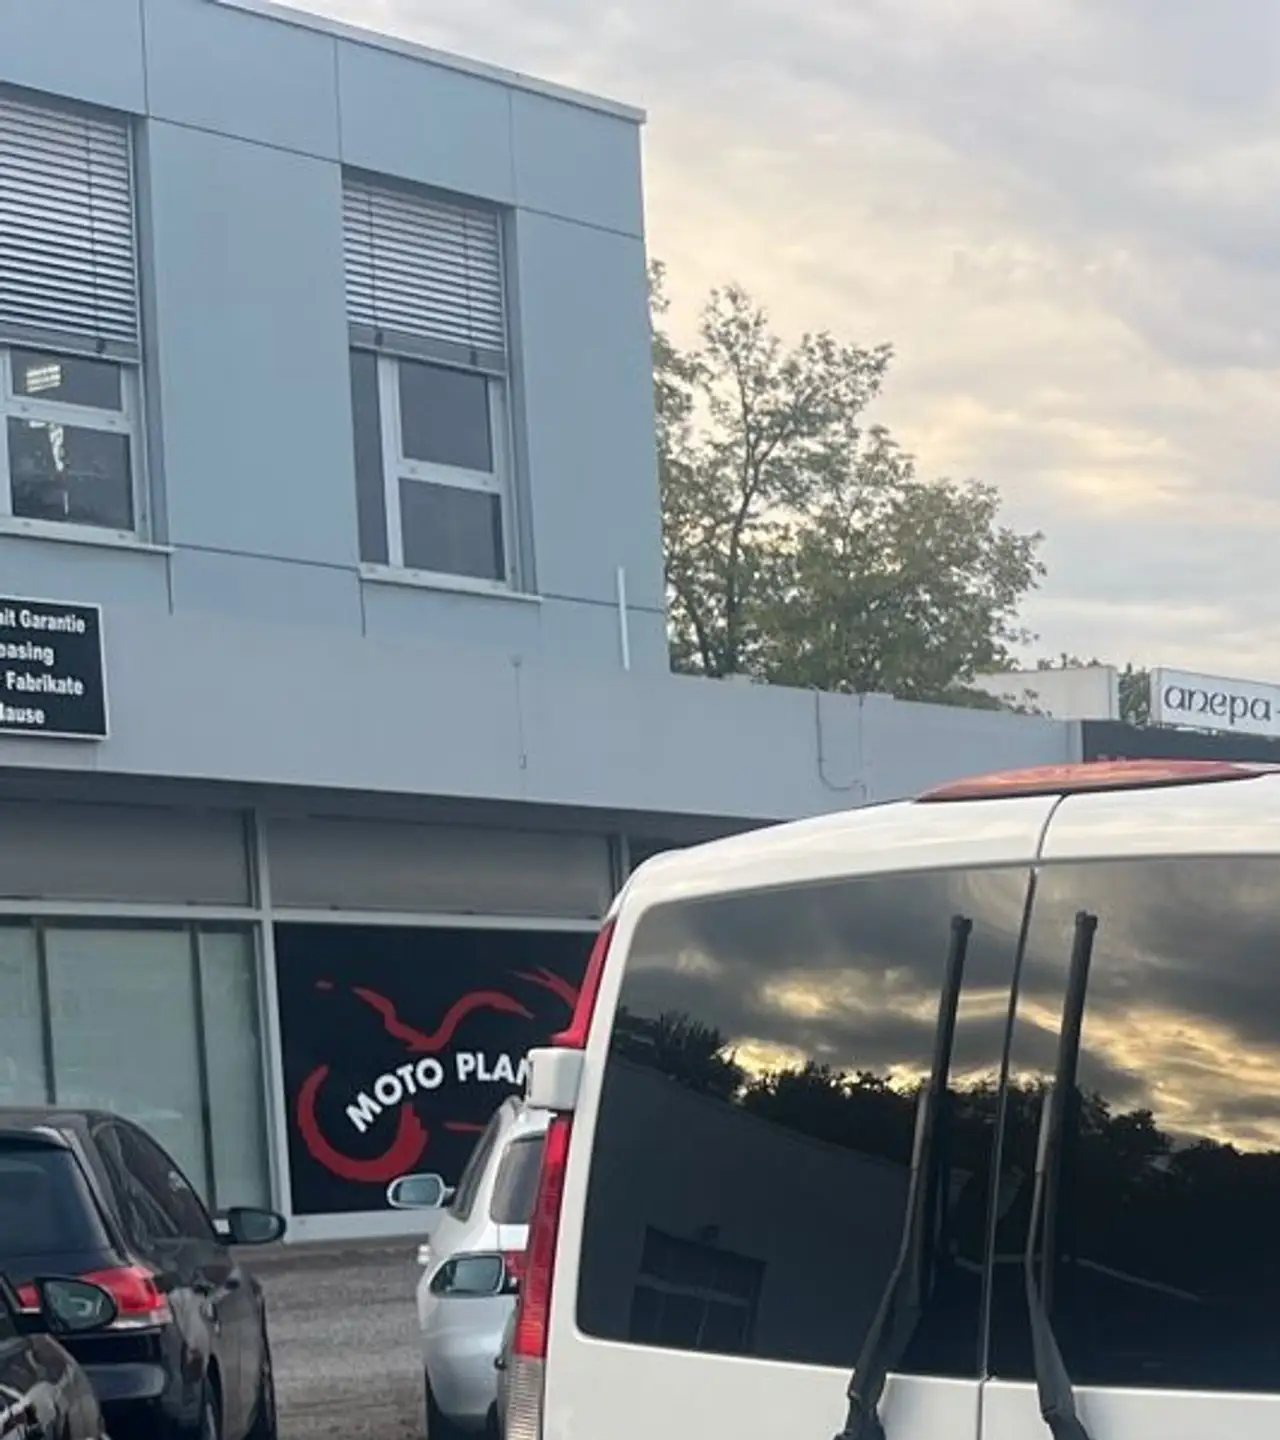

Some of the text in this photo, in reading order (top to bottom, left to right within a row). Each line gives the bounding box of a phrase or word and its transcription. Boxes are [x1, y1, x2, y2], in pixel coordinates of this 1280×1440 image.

[0, 607, 86, 634] it Garantie
[6, 671, 84, 696] Fabrikate
[346, 1057, 444, 1134] MOTO
